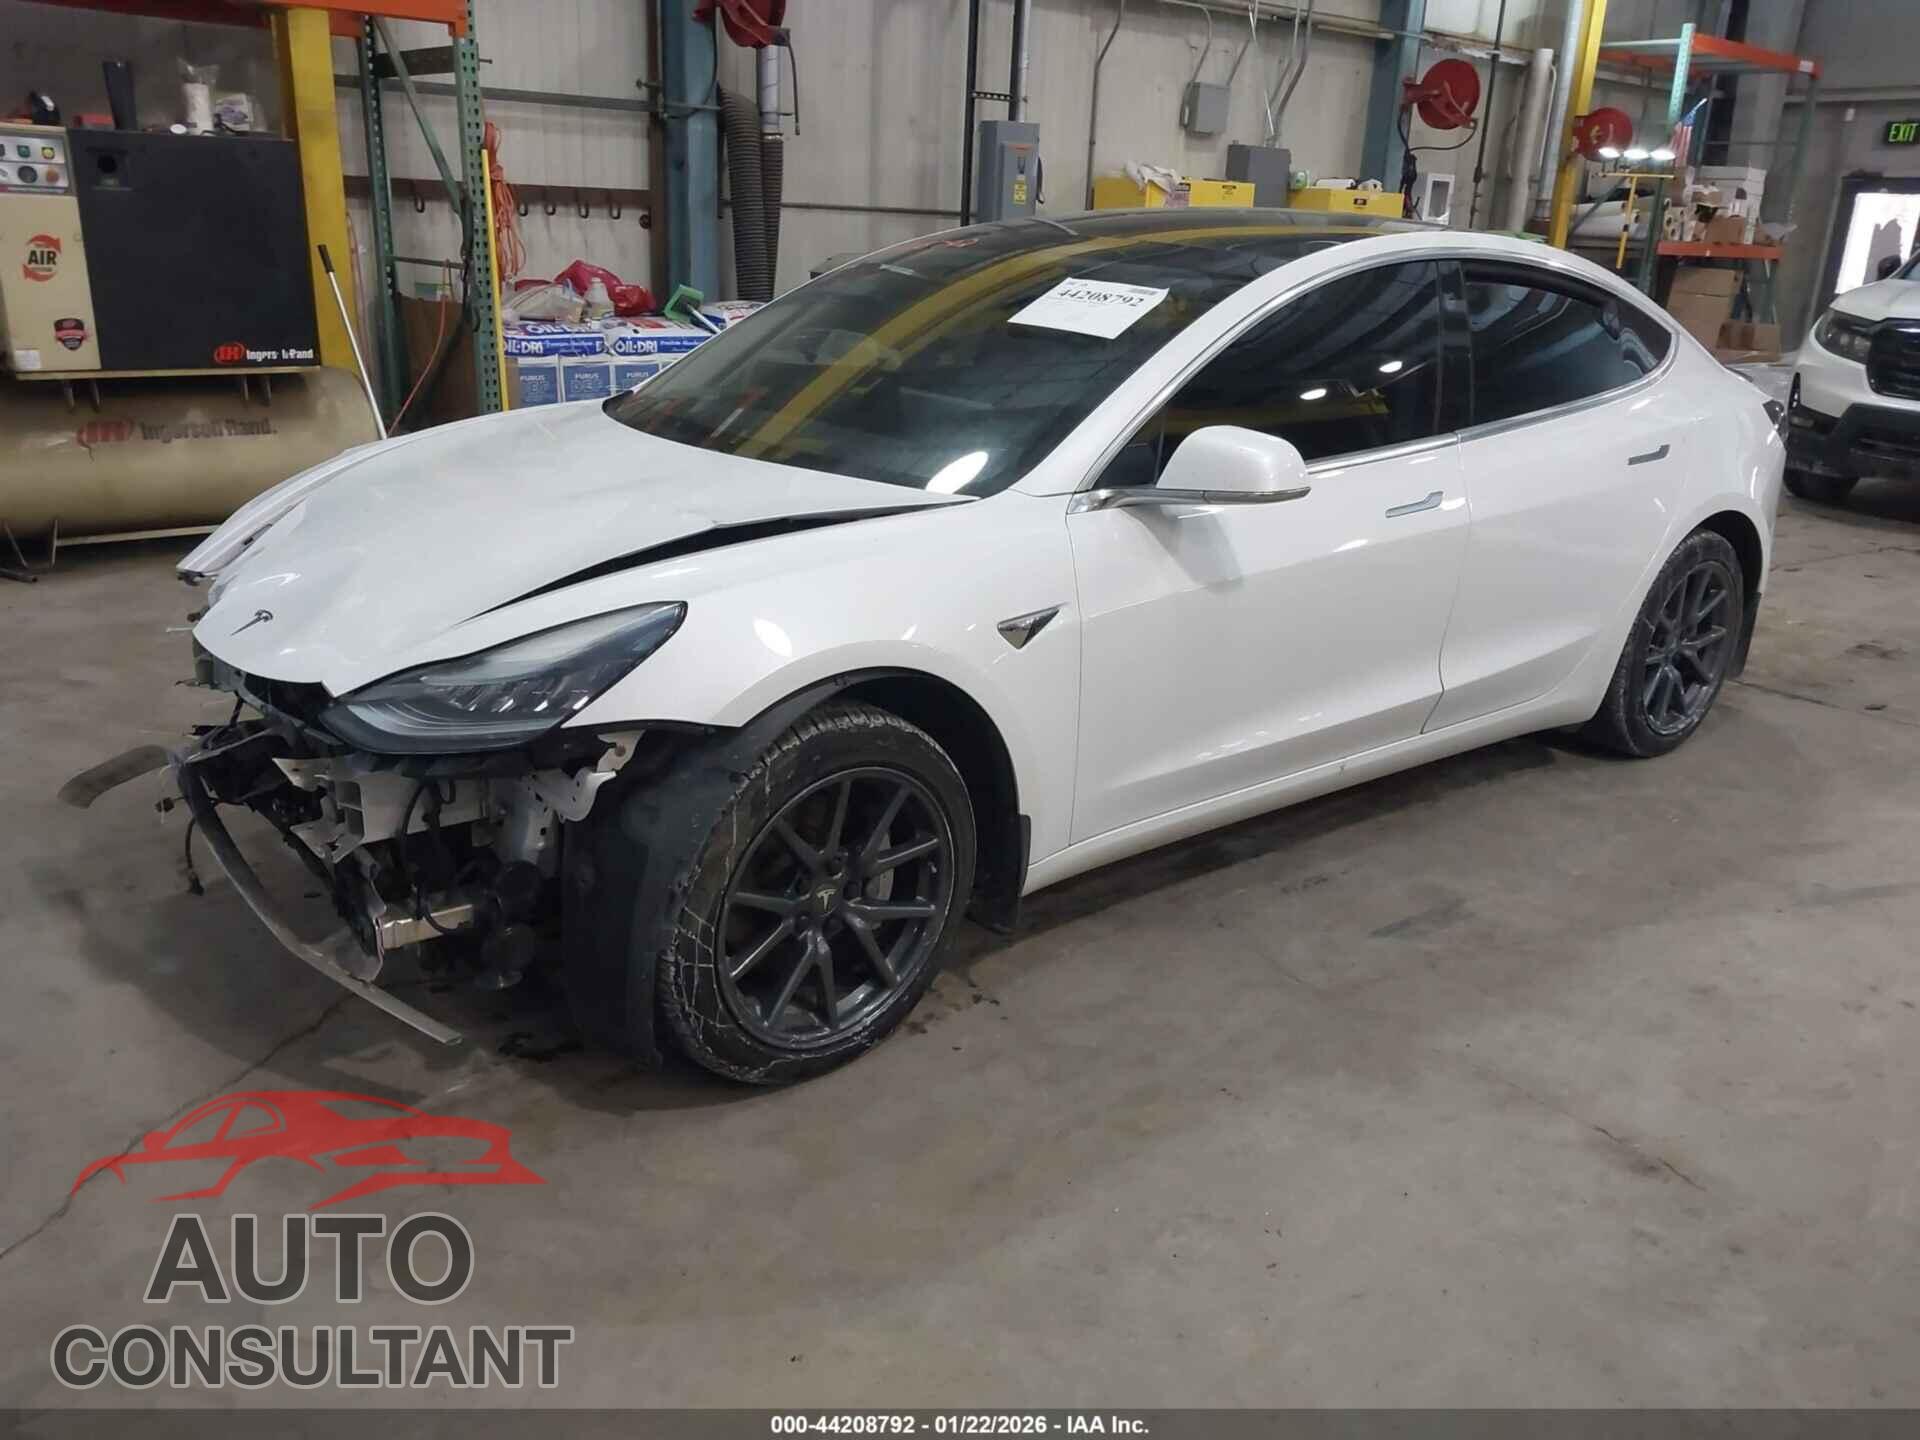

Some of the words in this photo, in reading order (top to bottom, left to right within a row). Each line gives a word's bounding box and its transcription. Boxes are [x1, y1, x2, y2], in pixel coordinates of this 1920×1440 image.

[1889, 122, 1918, 142] EXIT
[28, 249, 57, 266] AIR
[1057, 286, 1145, 307] 44208792
